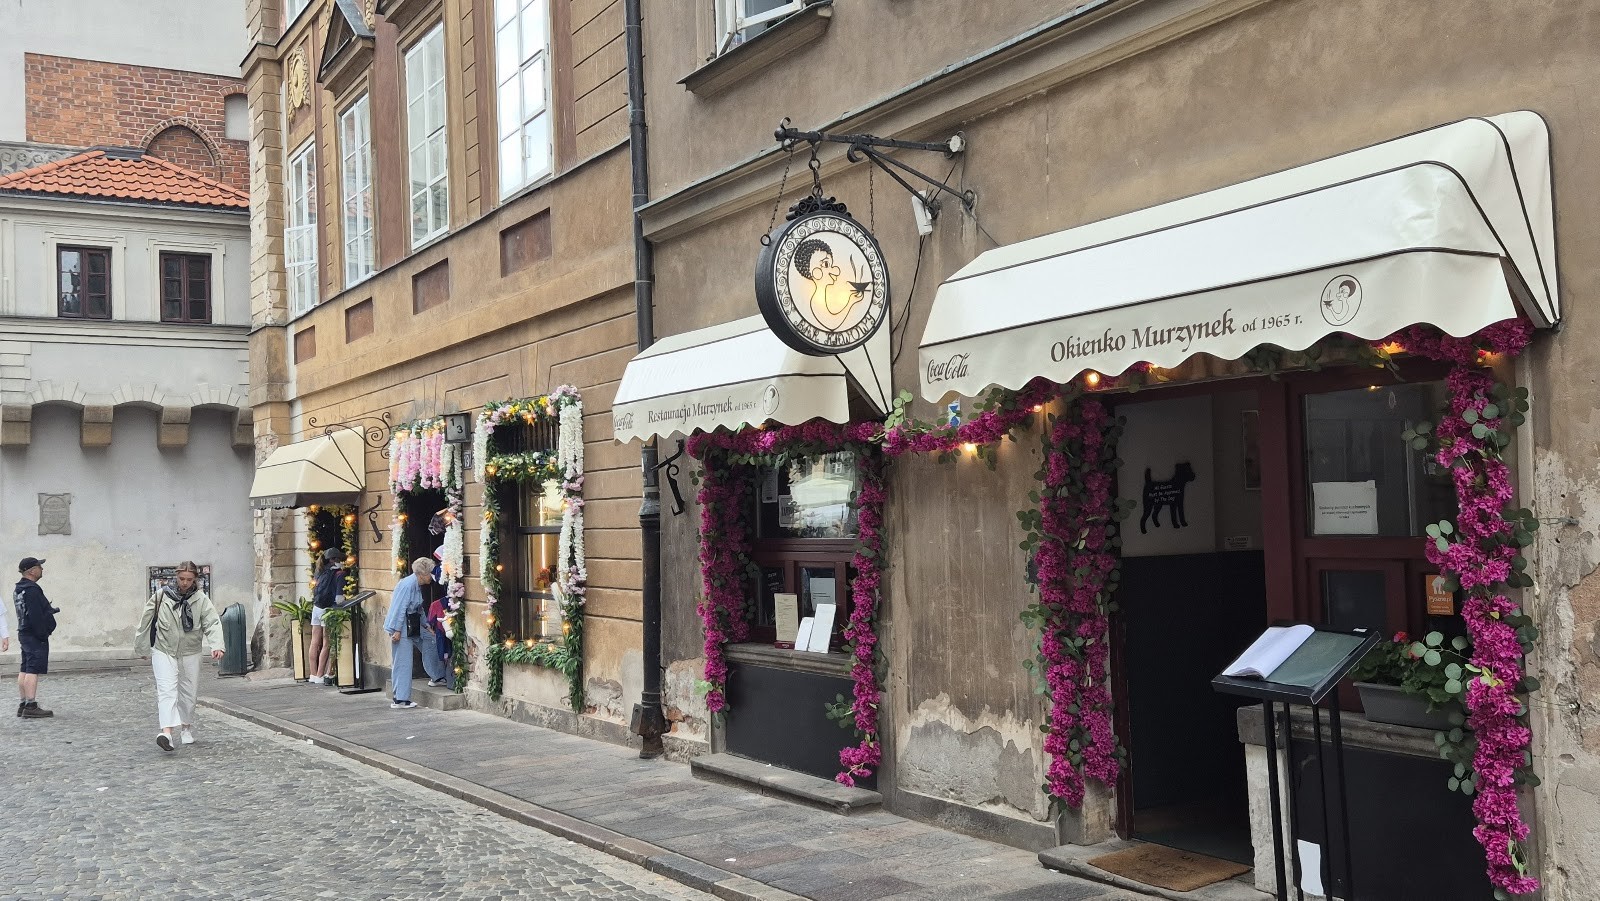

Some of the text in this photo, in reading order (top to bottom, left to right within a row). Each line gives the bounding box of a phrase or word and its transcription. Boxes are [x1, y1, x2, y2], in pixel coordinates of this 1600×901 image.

[794, 312, 876, 346] BAR KAWOWY
[1050, 308, 1303, 363] Okienko Murzynek od 1965 r.
[926, 353, 971, 385] Coca-Cola
[647, 405, 691, 425] Restauracja
[692, 395, 733, 421] Murzynek
[734, 402, 741, 411] od
[741, 401, 753, 411] 1965
